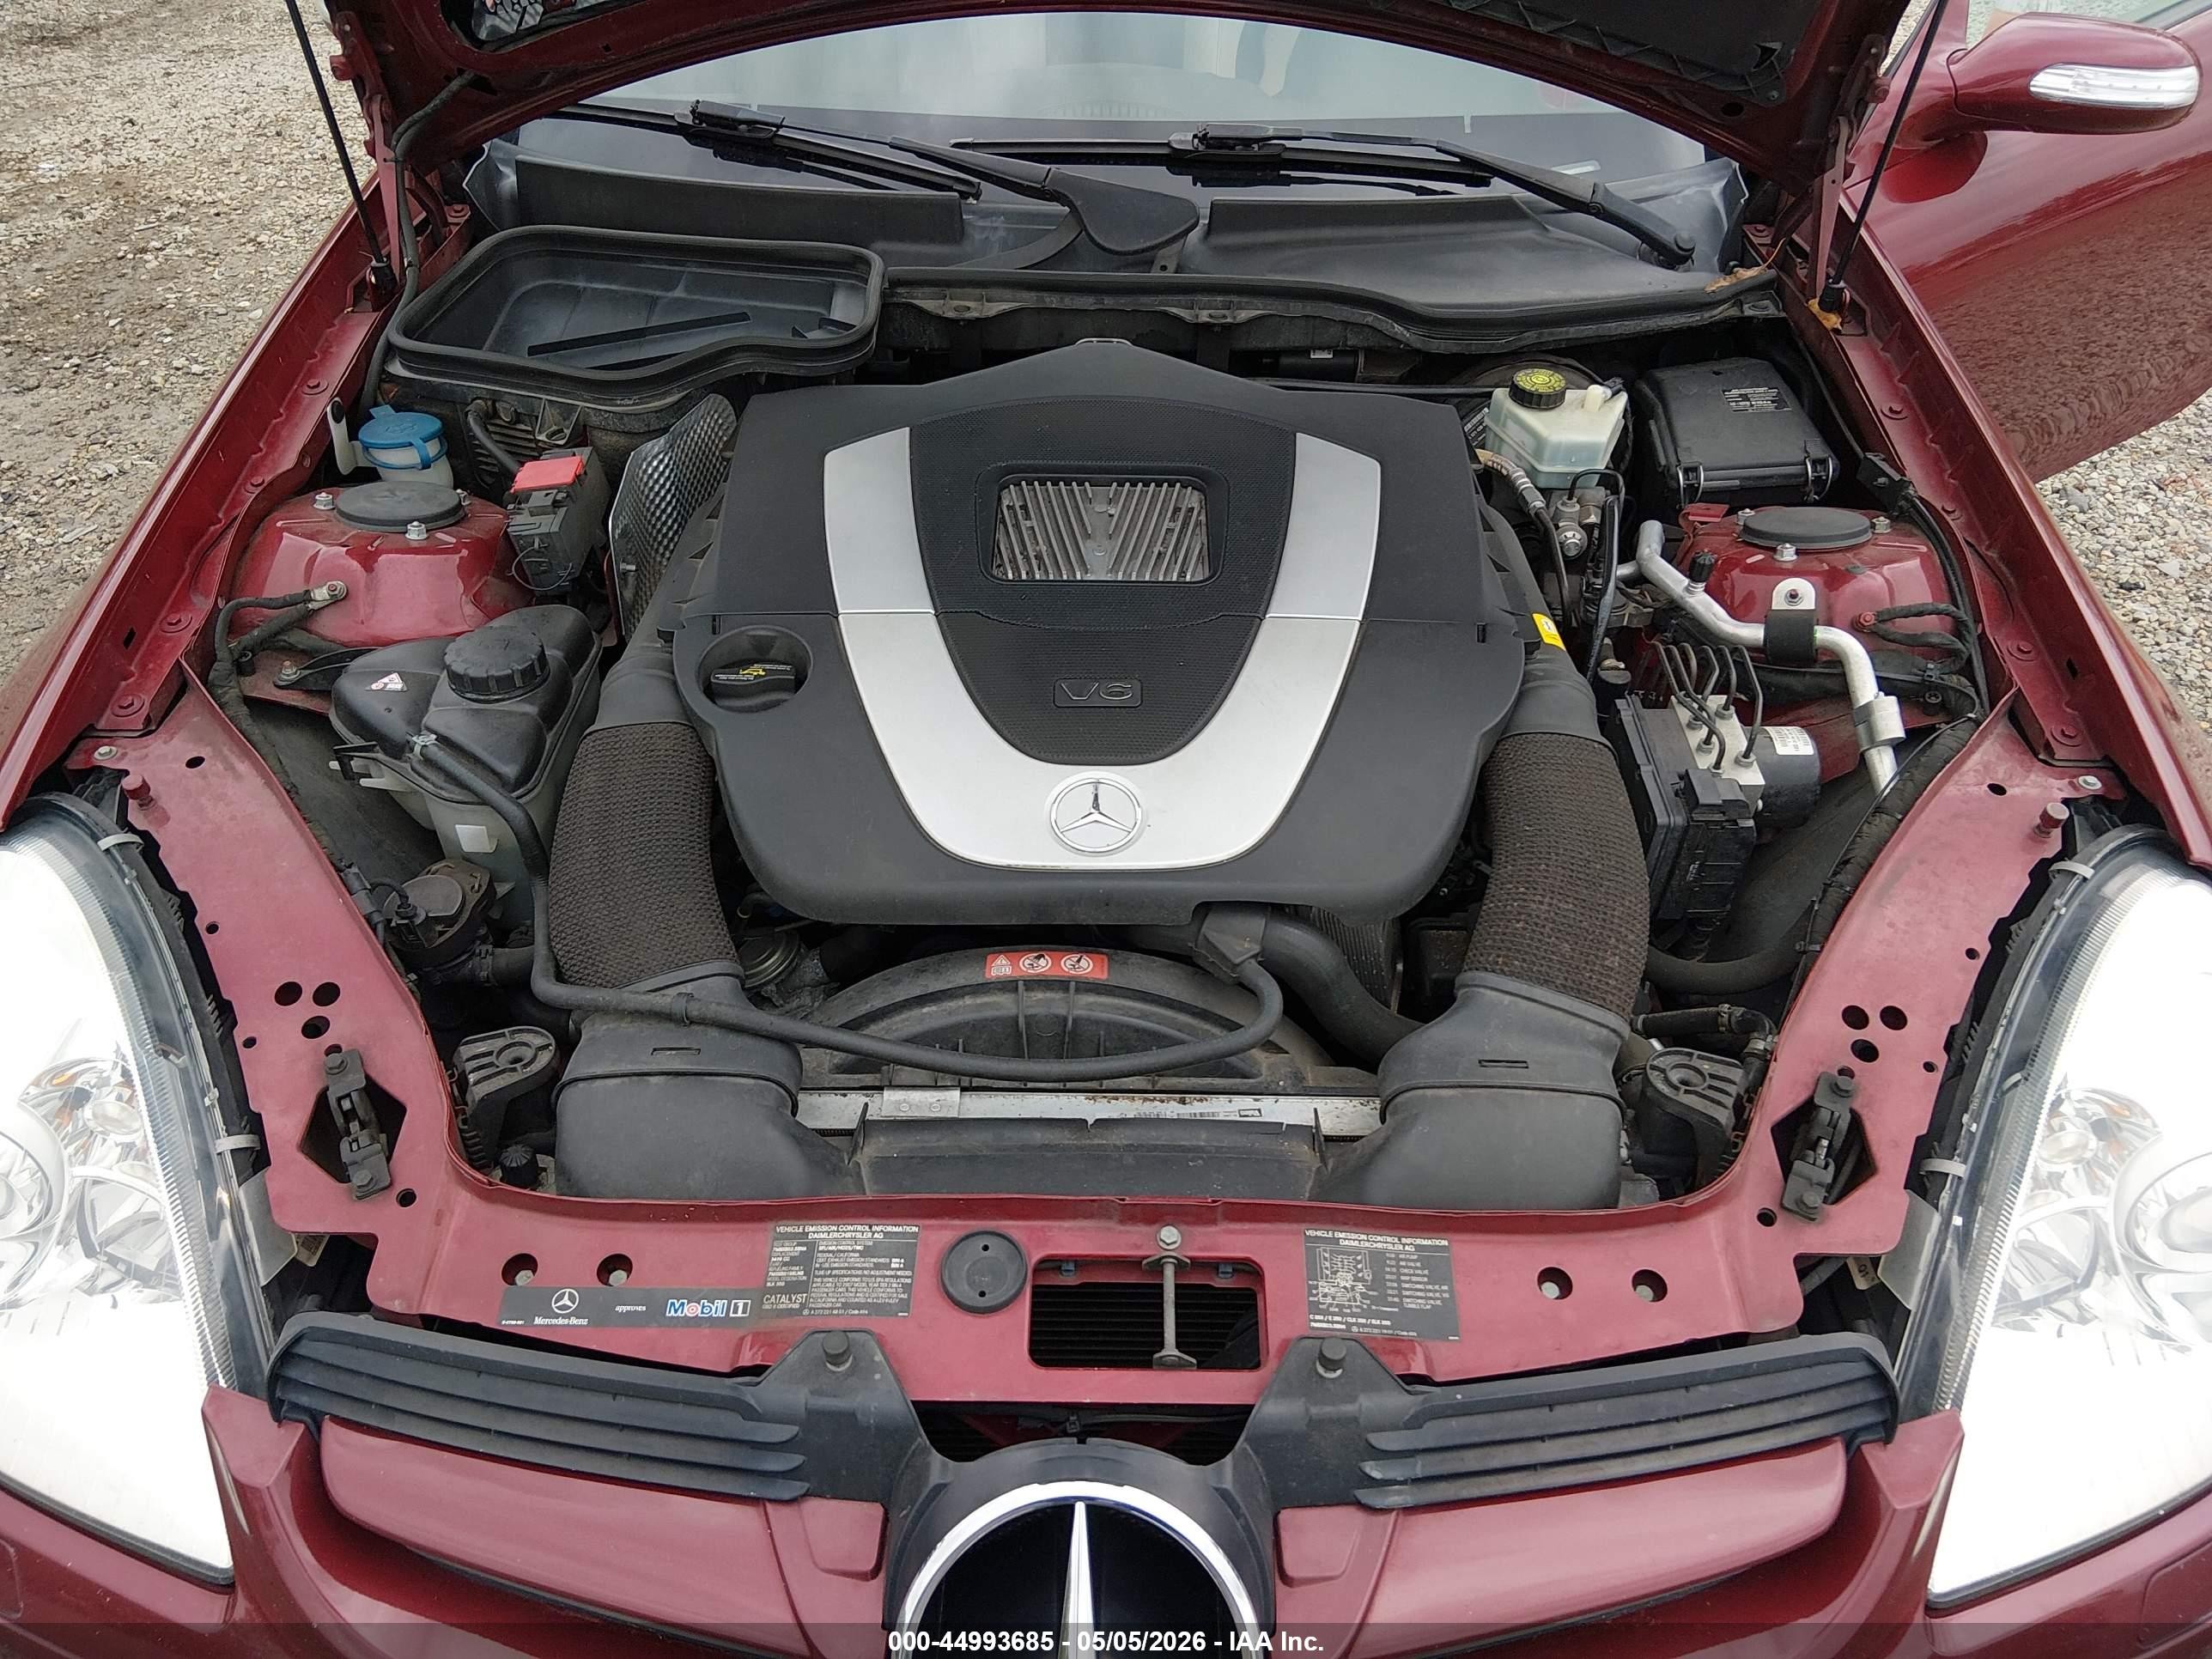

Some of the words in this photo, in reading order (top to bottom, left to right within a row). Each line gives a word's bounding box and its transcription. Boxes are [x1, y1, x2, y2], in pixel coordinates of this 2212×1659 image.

[1060, 682, 1133, 701] V6
[1305, 1229, 1334, 1238] VEHICLE
[1334, 1232, 1367, 1241] EMISSION
[1368, 1234, 1401, 1243] CONTROL
[1401, 1237, 1449, 1246] INFORMATION
[1339, 1239, 1404, 1251] DAIMLERCHRYSLER
[763, 1293, 808, 1304] CATALYST
[615, 1304, 647, 1313] approves
[665, 1299, 728, 1317] Mobil
[533, 1316, 589, 1325] Mercedes-Benz
